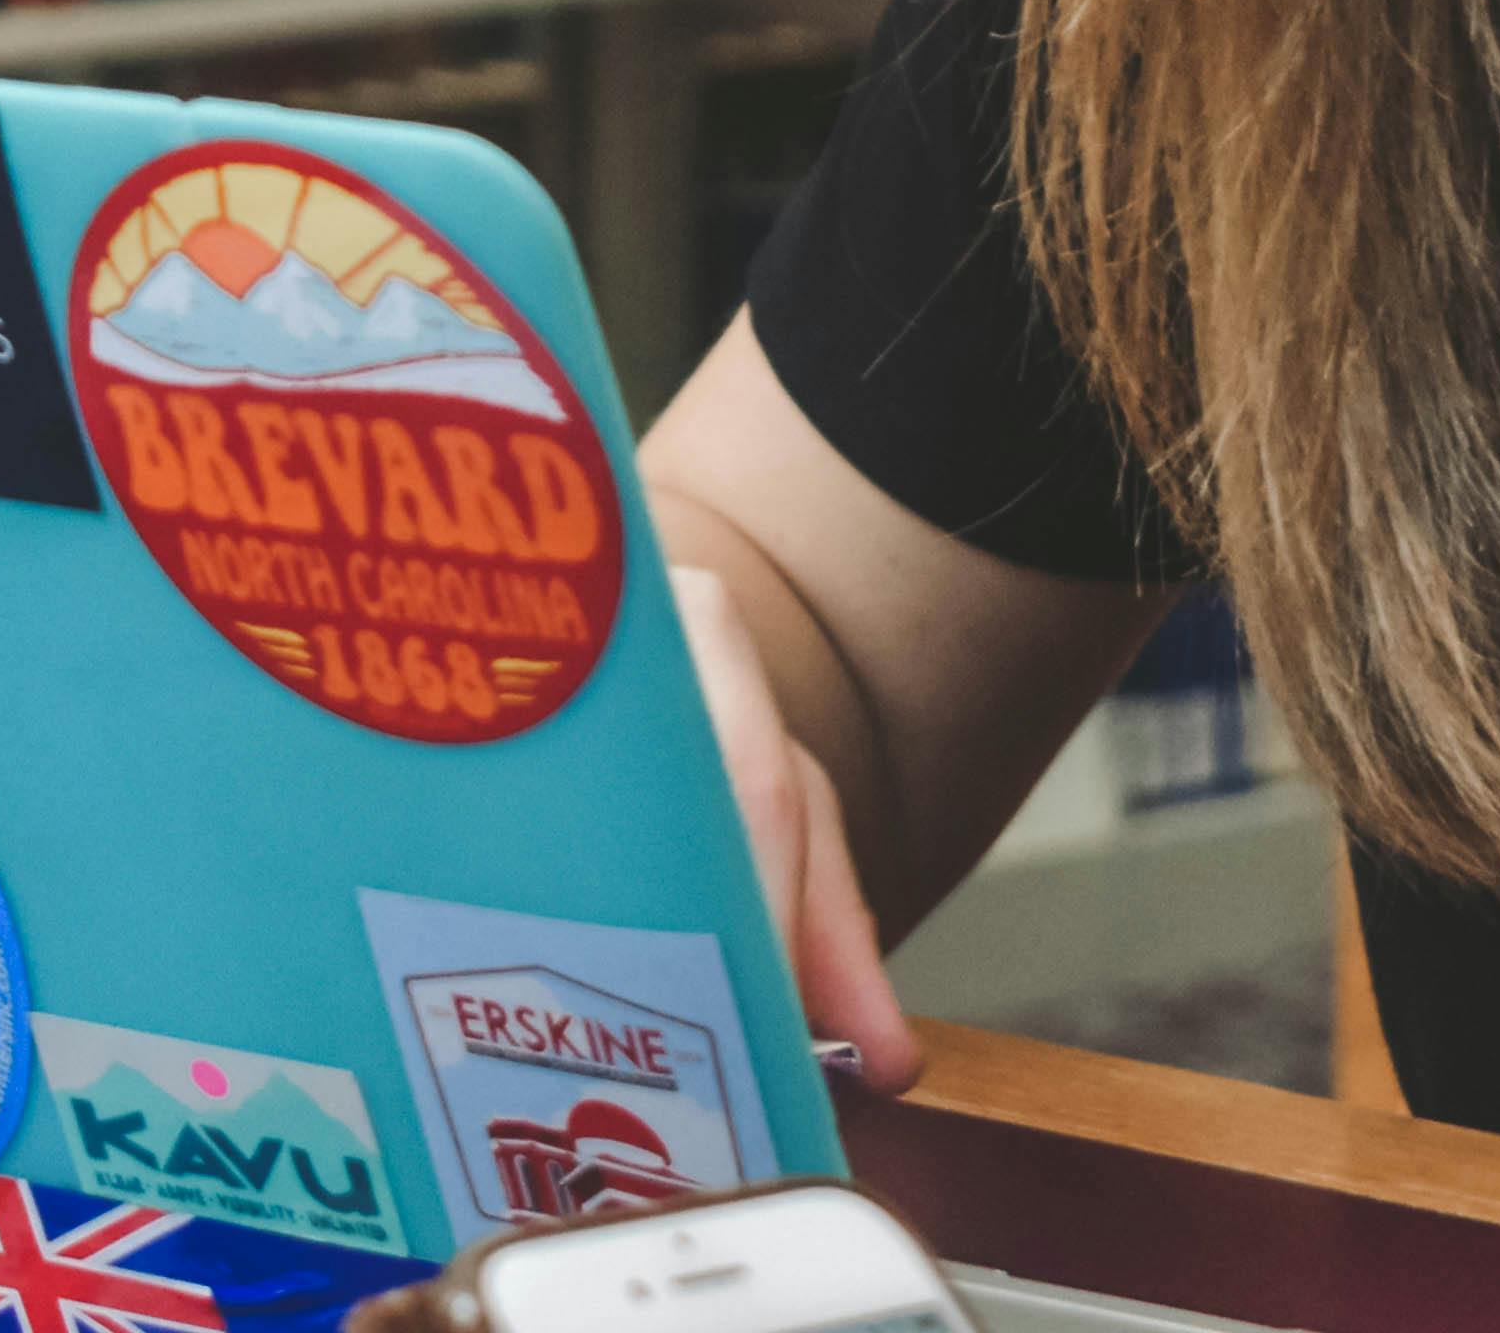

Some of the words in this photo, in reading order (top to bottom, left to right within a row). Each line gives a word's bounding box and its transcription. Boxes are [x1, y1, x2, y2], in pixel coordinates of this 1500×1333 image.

[106, 383, 601, 562] BREVARD
[180, 527, 344, 610] NORTH
[347, 553, 591, 643] CAROLINA
[312, 624, 500, 723] 1868
[452, 992, 675, 1076] ERSKINE
[70, 1096, 381, 1217] KAVU
